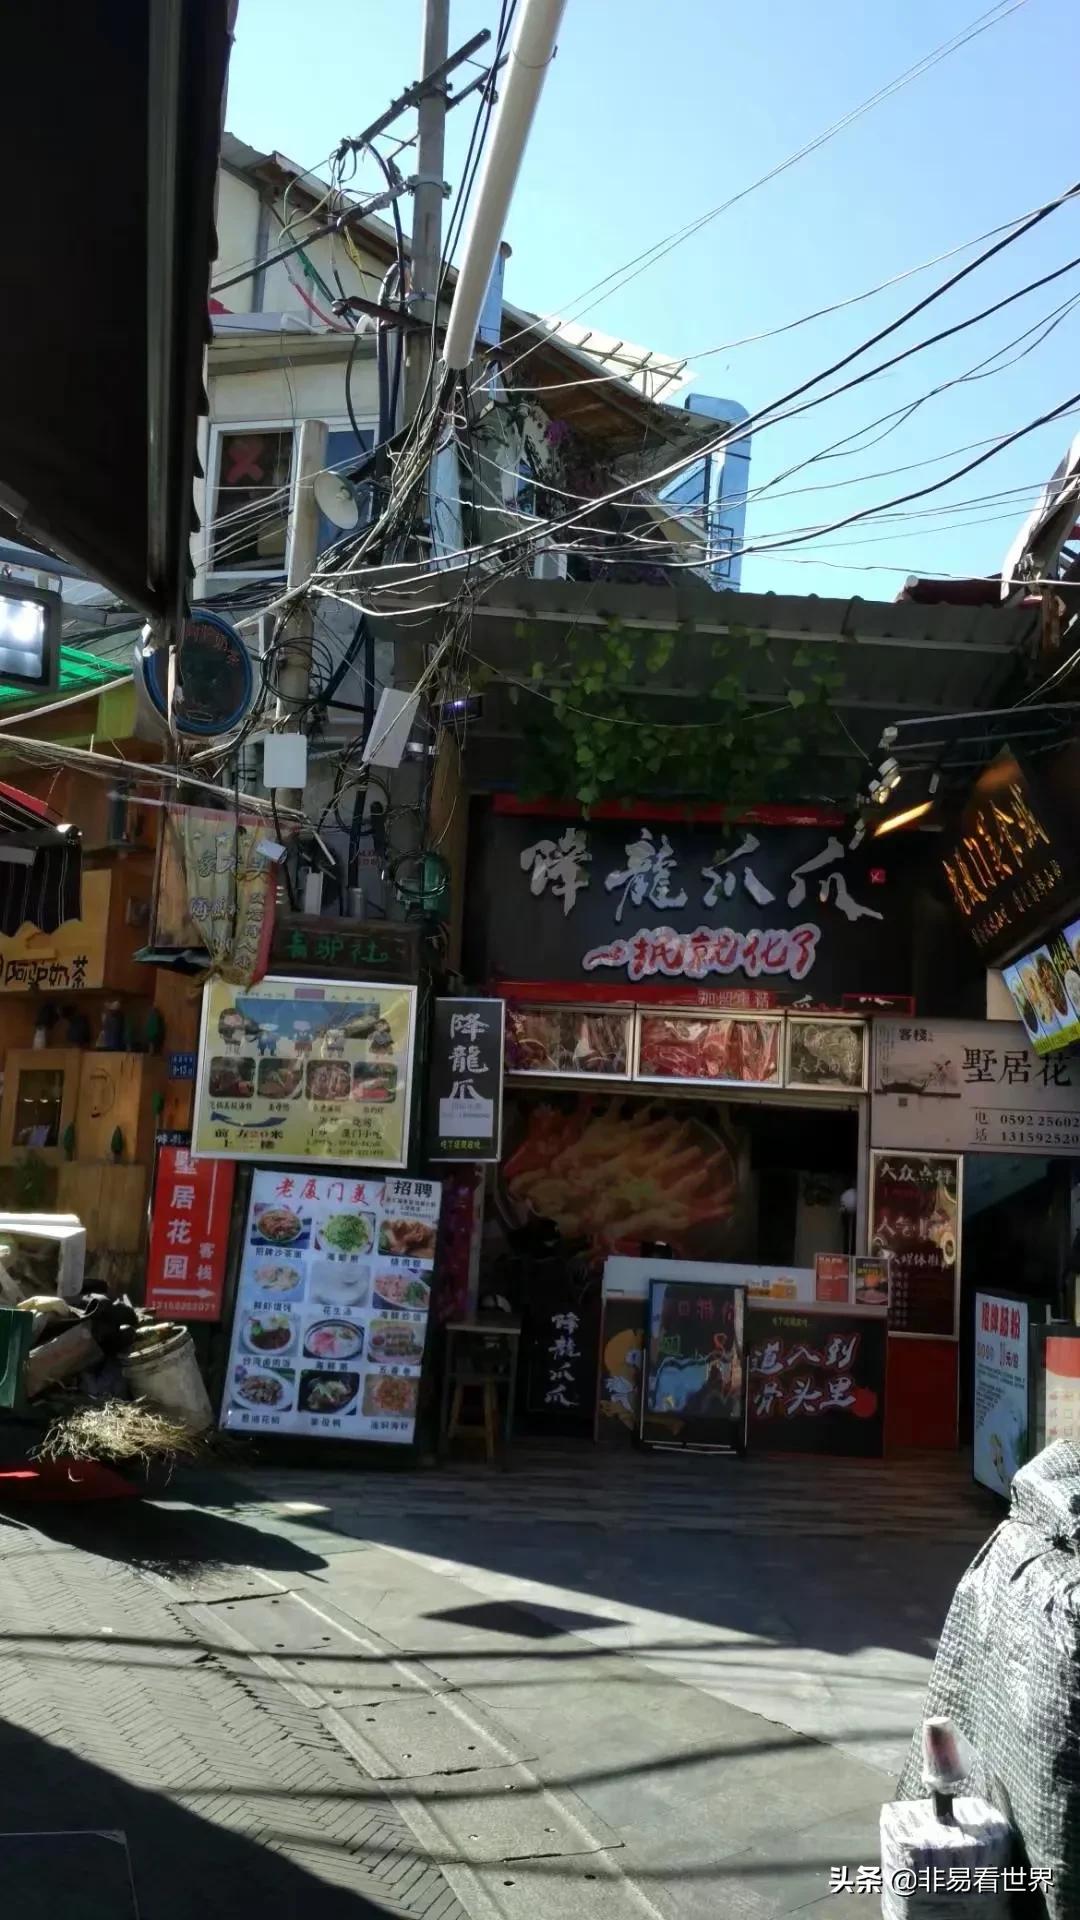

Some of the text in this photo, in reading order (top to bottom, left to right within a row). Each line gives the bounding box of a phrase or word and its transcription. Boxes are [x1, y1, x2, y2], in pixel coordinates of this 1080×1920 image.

[962, 1047, 1072, 1087] 墅居花
[1000, 1114, 1034, 1128] 0592
[394, 1180, 433, 1198] 招聘
